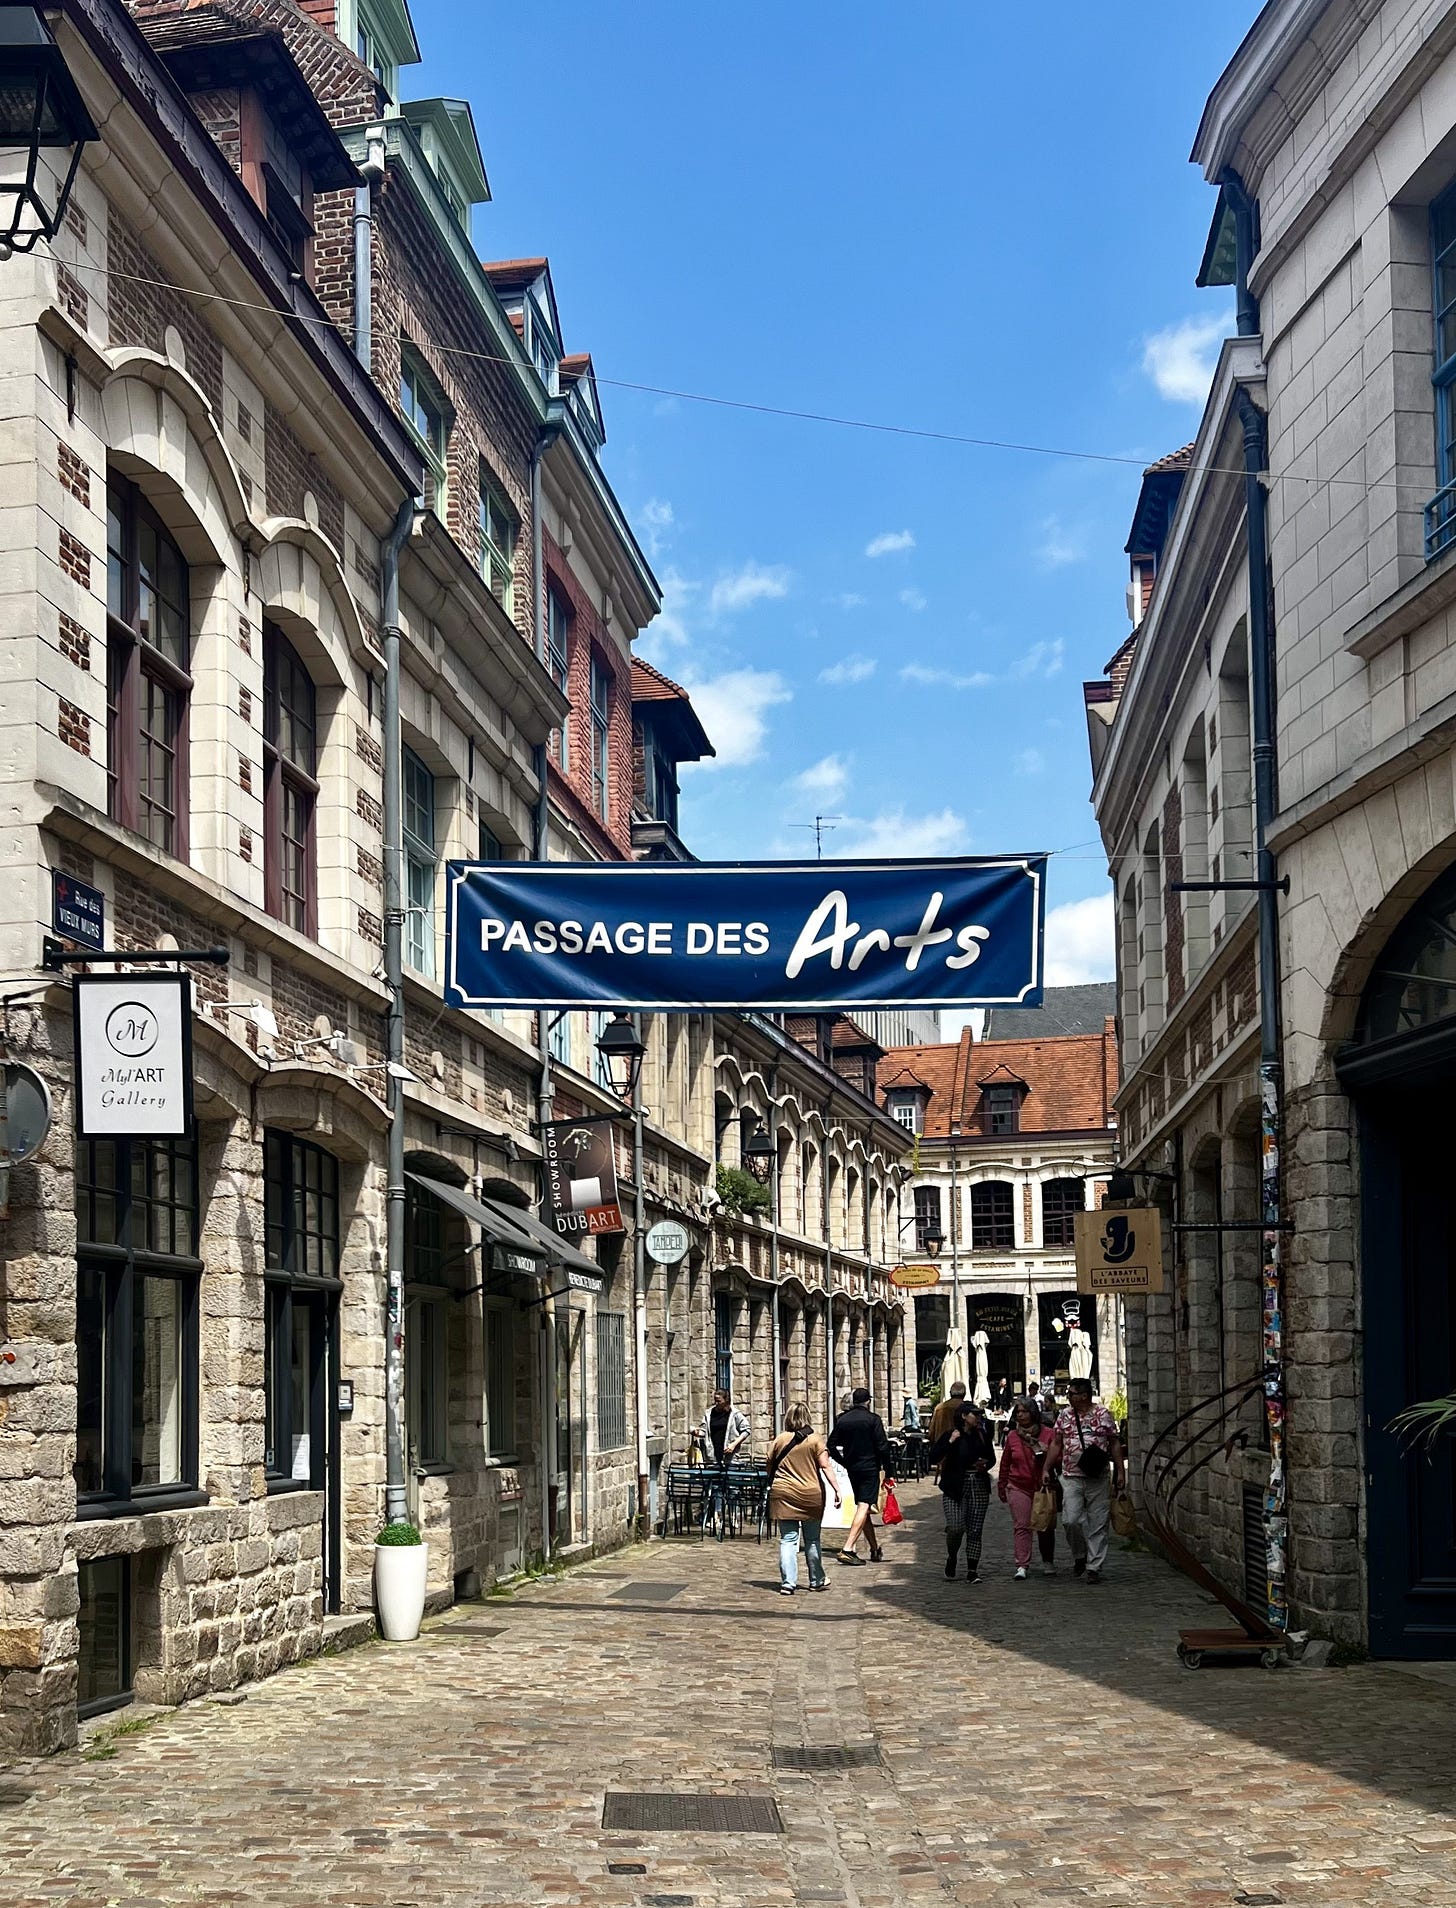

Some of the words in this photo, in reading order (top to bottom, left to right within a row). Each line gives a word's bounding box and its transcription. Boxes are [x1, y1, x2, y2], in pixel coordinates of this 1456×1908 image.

[75, 890, 88, 909] Rue
[89, 899, 101, 916] des
[59, 907, 80, 930] VIEUX
[81, 917, 100, 939] MURS
[480, 919, 673, 955] PASSAGE
[686, 922, 770, 956] DES
[785, 889, 990, 979] Arts
[101, 1089, 166, 1109] Gallery
[546, 1127, 562, 1209] SHOWROOM
[556, 1210, 616, 1233] DUBART
[1101, 1269, 1137, 1277] L'ABBAYE
